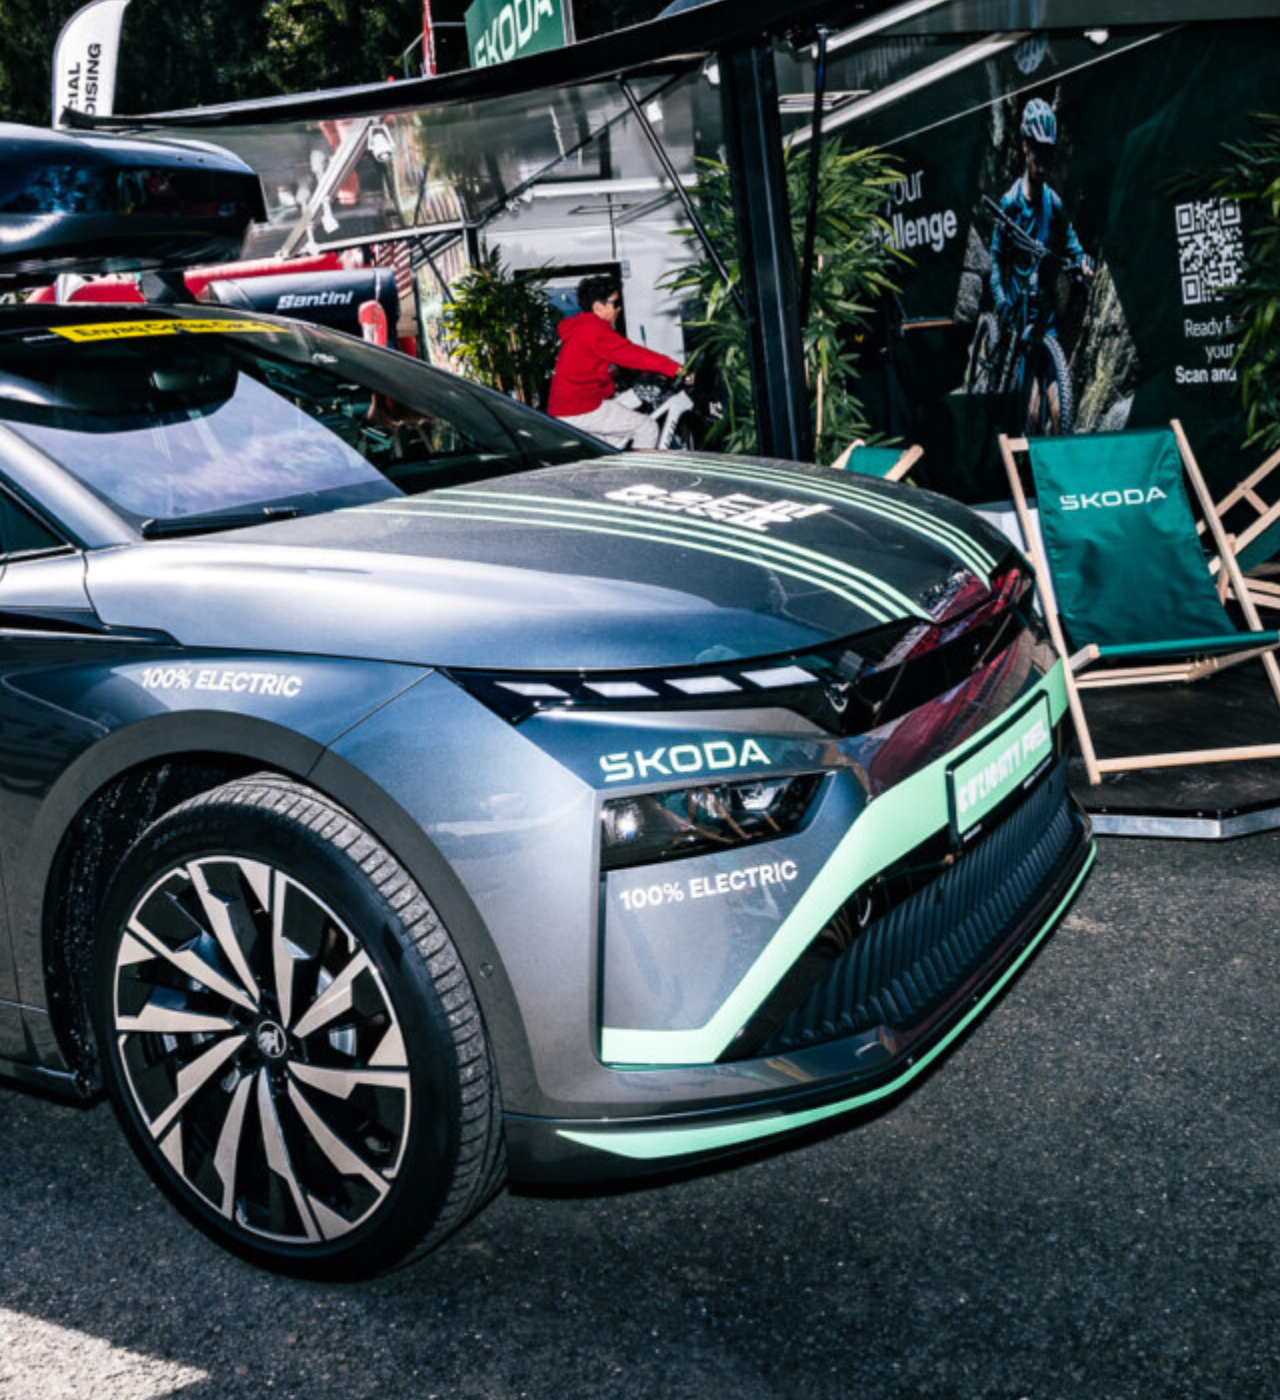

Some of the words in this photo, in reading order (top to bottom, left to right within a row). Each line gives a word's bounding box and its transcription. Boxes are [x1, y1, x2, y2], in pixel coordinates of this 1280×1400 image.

[277, 290, 354, 309] Santini
[1183, 316, 1224, 337] Ready
[1205, 343, 1235, 364] your
[1175, 365, 1209, 384] Scan
[1211, 367, 1237, 382] and
[142, 667, 193, 689] 100%
[194, 669, 303, 697] ELECTRIC
[619, 881, 685, 910] 100%
[687, 860, 799, 899] ELECTRIC
